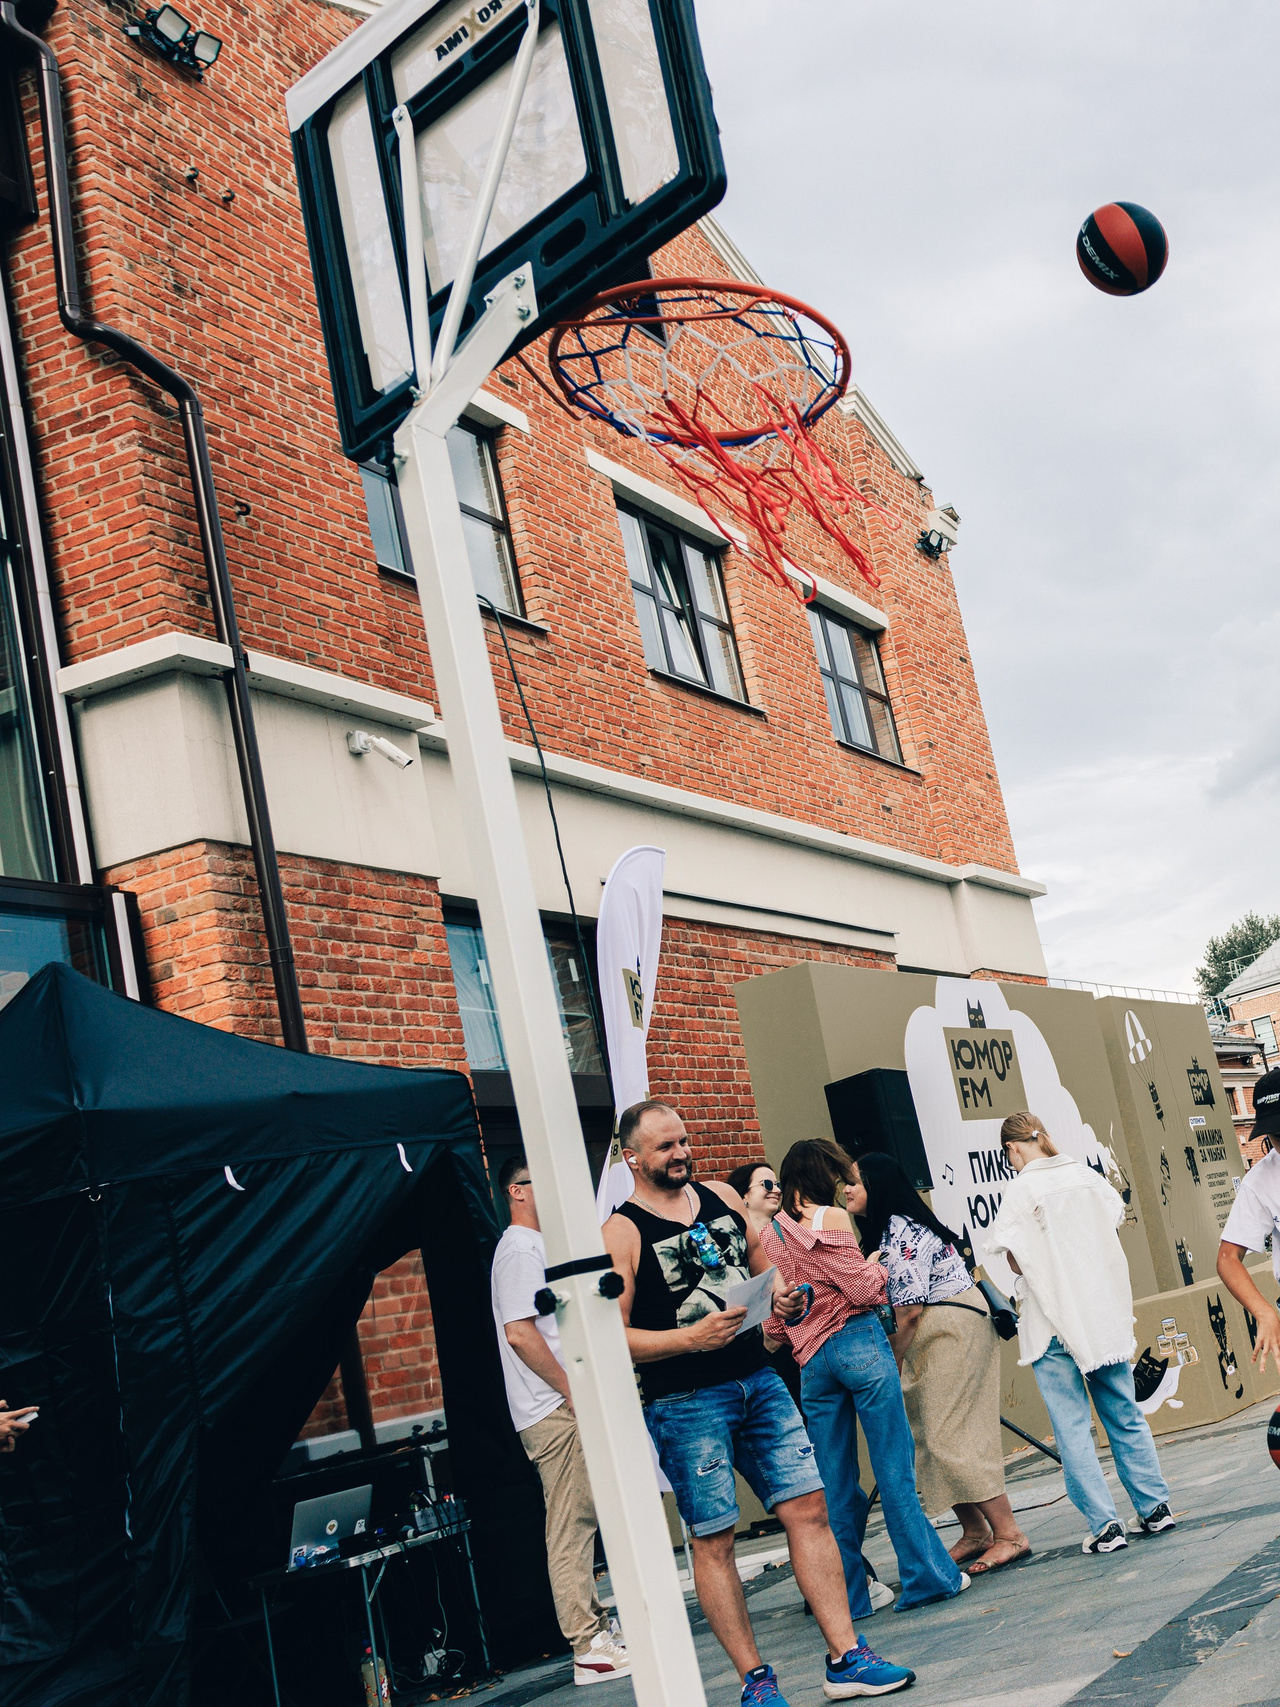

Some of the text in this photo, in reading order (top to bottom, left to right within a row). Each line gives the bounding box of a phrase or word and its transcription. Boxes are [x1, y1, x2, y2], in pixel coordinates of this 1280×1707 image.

[1082, 235, 1119, 279] DEMIX
[950, 1038, 1013, 1082] ЮМОР
[959, 1077, 993, 1109] FM
